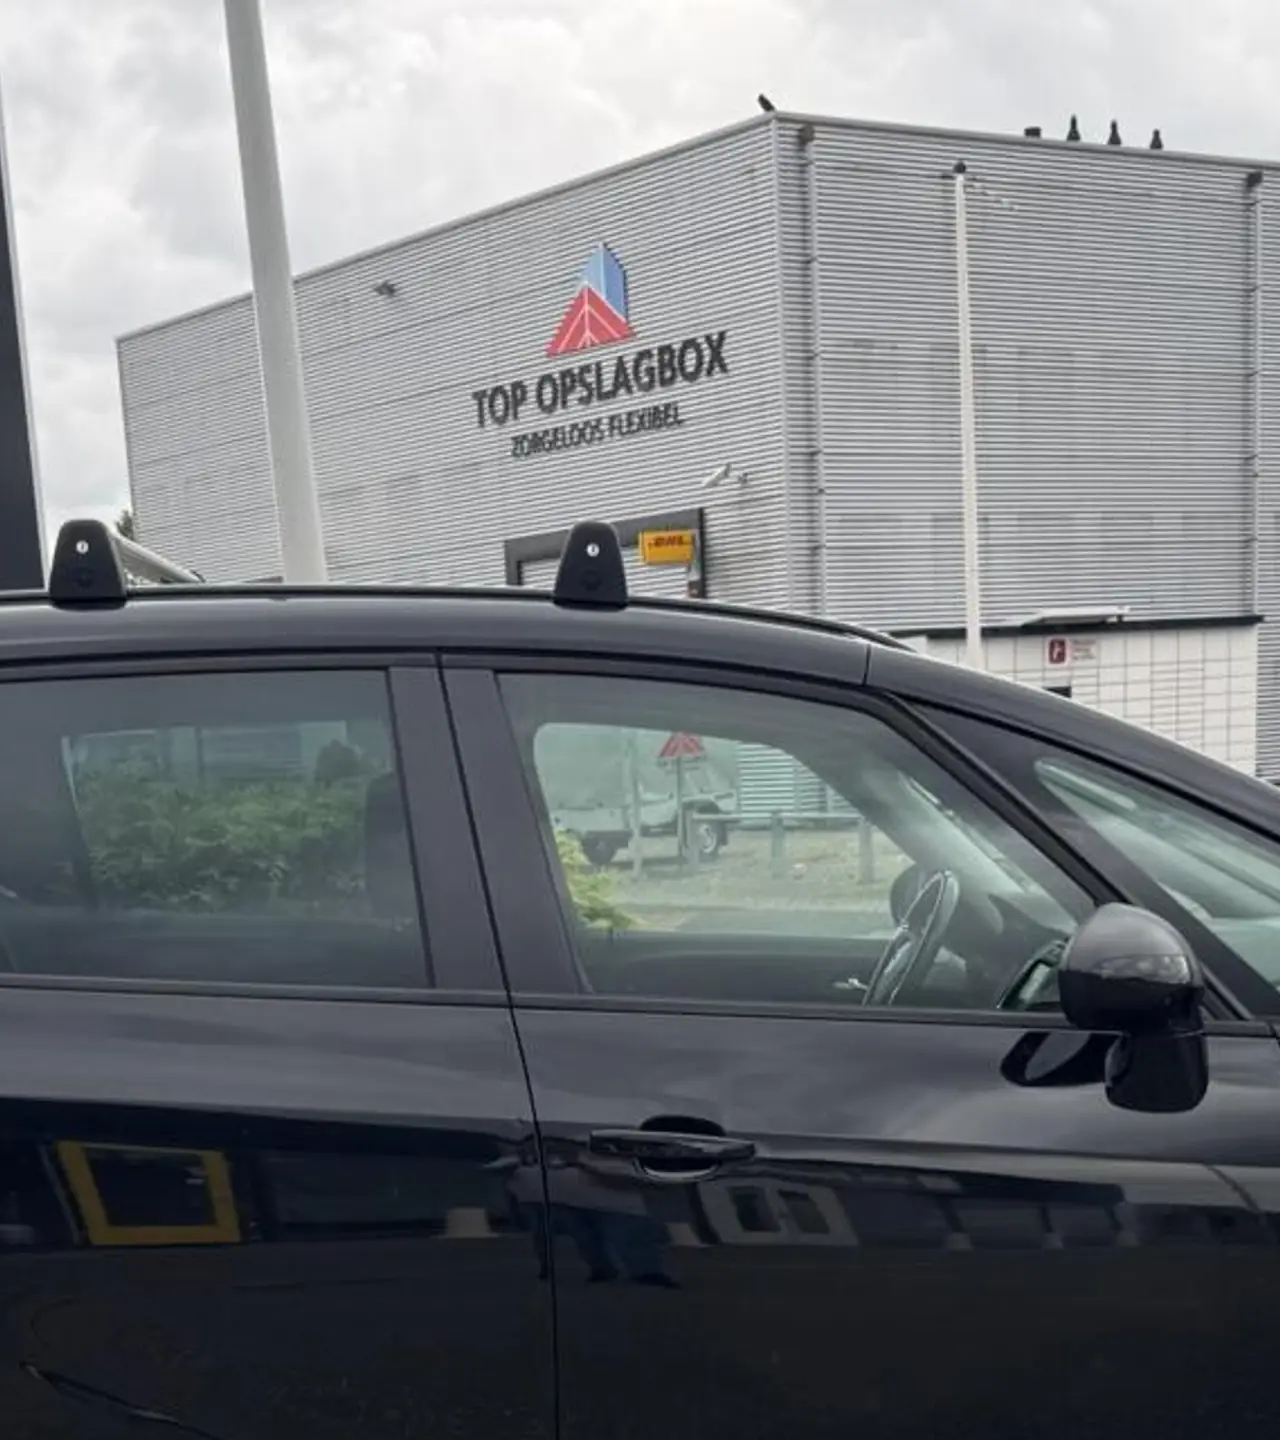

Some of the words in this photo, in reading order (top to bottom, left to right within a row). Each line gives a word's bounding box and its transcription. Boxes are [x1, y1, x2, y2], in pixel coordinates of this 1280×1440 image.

[472, 380, 527, 428] TOP
[536, 331, 729, 413] OPSLAGBOX
[608, 402, 685, 438] FLEXIBEL
